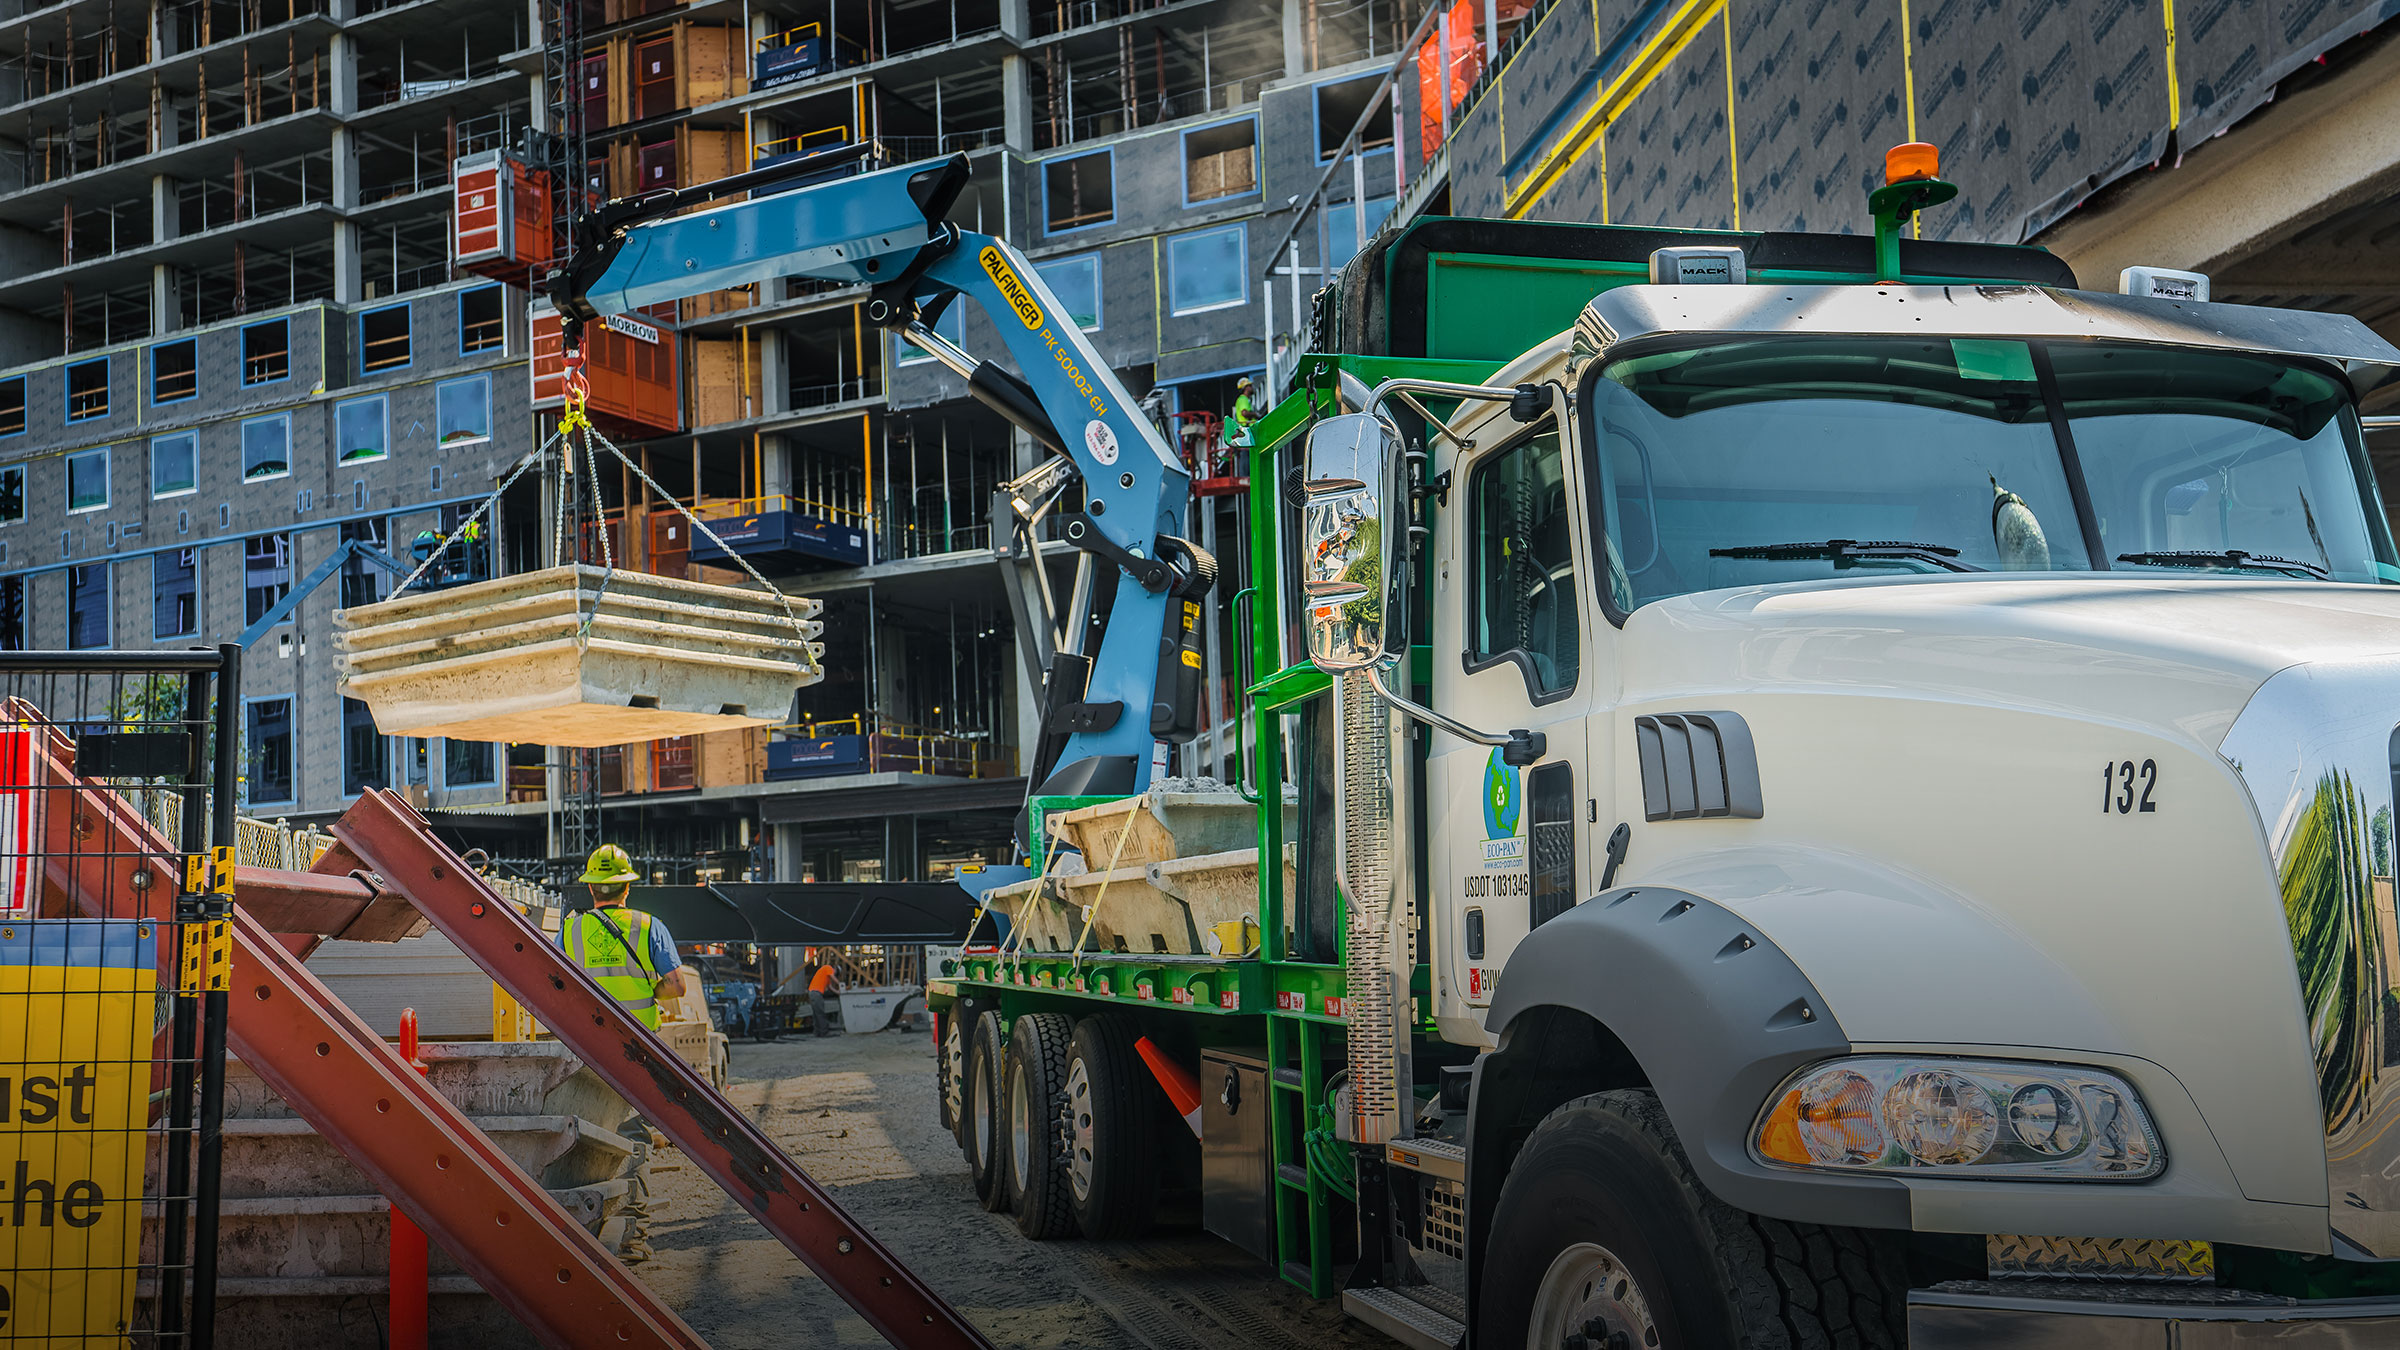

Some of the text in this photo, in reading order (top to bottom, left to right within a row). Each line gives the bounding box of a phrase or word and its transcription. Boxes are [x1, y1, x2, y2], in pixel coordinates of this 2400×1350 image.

[982, 250, 1039, 326] PALFINGER
[2153, 287, 2193, 298] MACK
[607, 315, 656, 341] MORROW
[1039, 328, 1059, 351] PK
[2103, 758, 2157, 815] 132
[1487, 840, 1516, 858] ECO-PAN
[1464, 873, 1529, 898] USDOT 1031346
